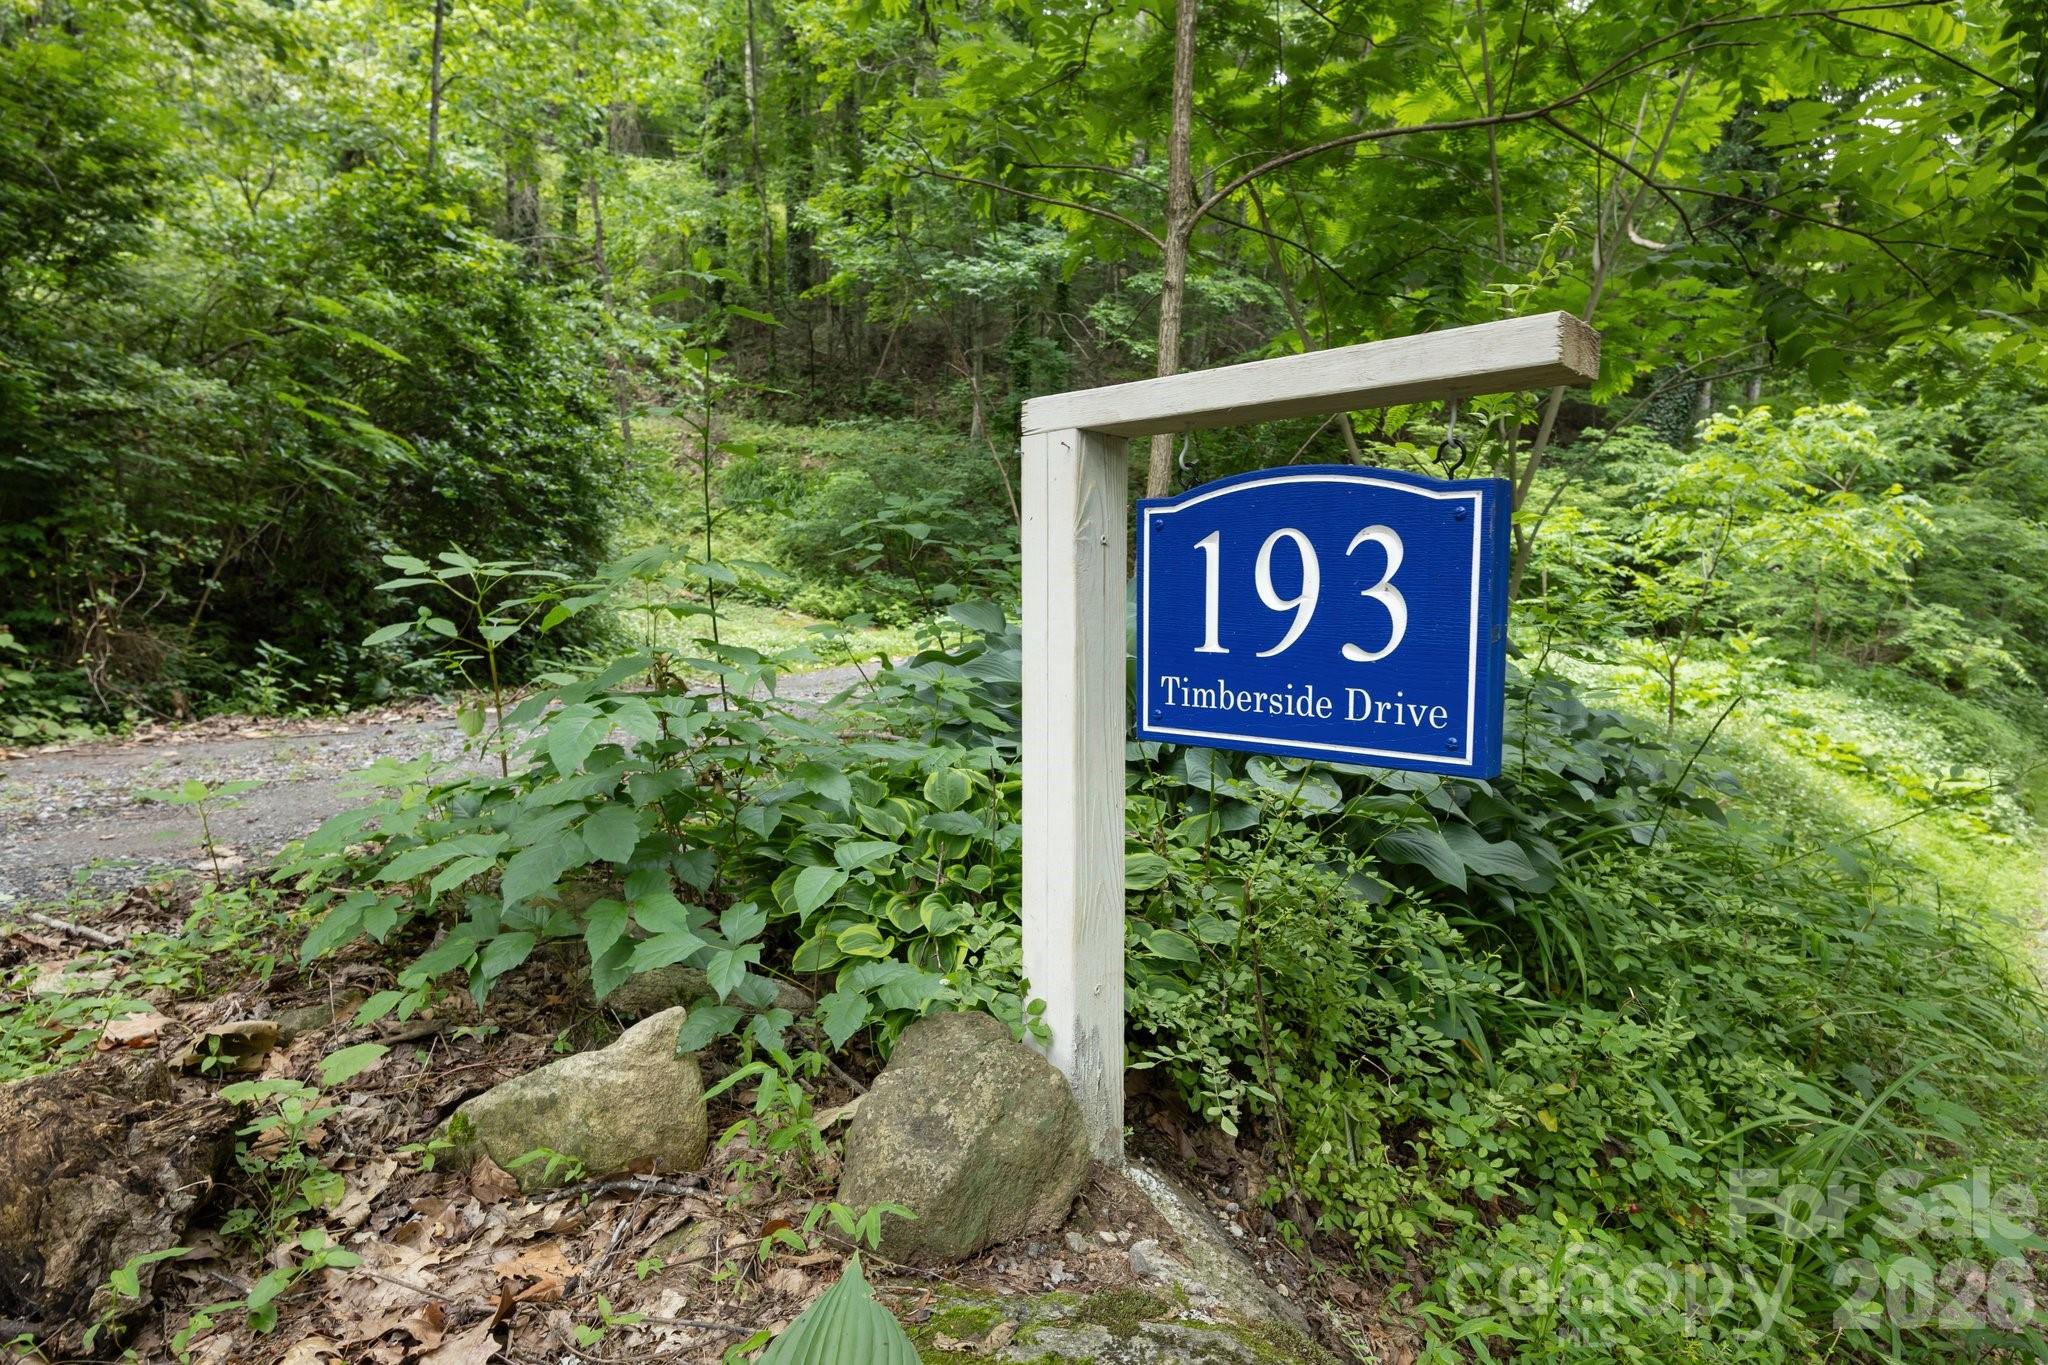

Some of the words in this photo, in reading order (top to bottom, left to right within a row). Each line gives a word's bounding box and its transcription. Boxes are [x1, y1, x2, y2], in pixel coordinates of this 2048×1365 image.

[1193, 524, 1408, 662] 193
[1160, 675, 1333, 719] Timberside
[1344, 687, 1449, 729] Drive
